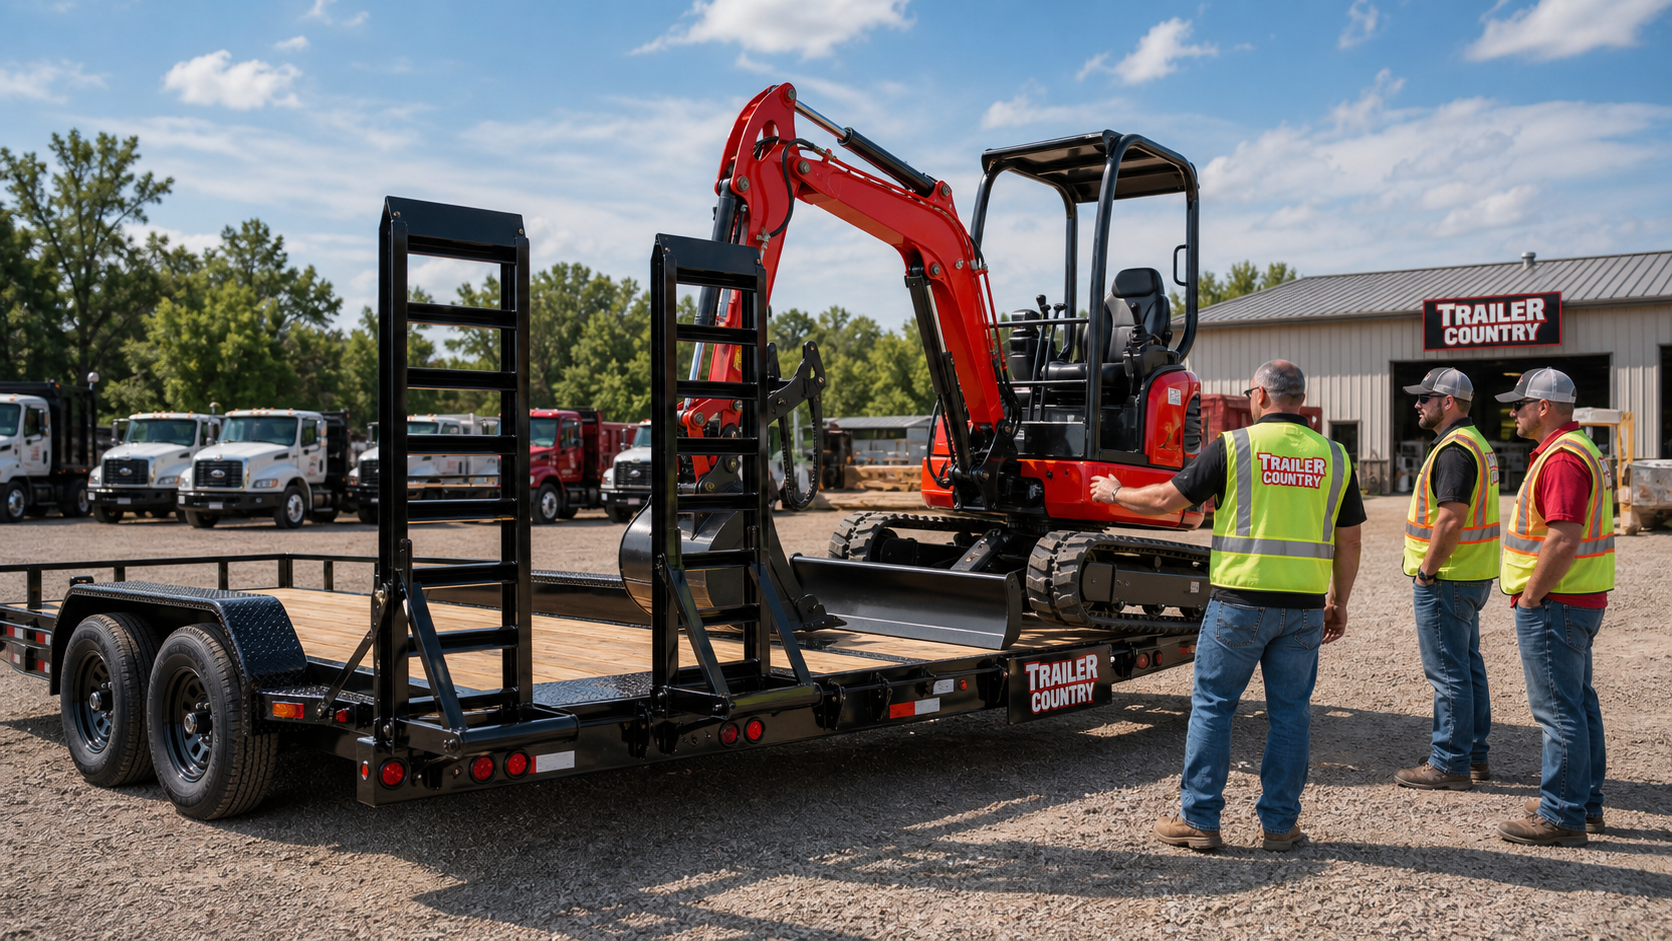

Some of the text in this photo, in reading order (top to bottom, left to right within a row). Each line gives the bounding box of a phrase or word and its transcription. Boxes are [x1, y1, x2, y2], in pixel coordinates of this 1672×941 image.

[1437, 298, 1546, 327] TRAILER
[1444, 323, 1540, 346] COUNTRY
[1258, 453, 1325, 475] TRAILER
[1263, 471, 1321, 488] COUNTRY
[1025, 654, 1098, 691] TRAILER
[1031, 682, 1094, 713] COUNTRY
